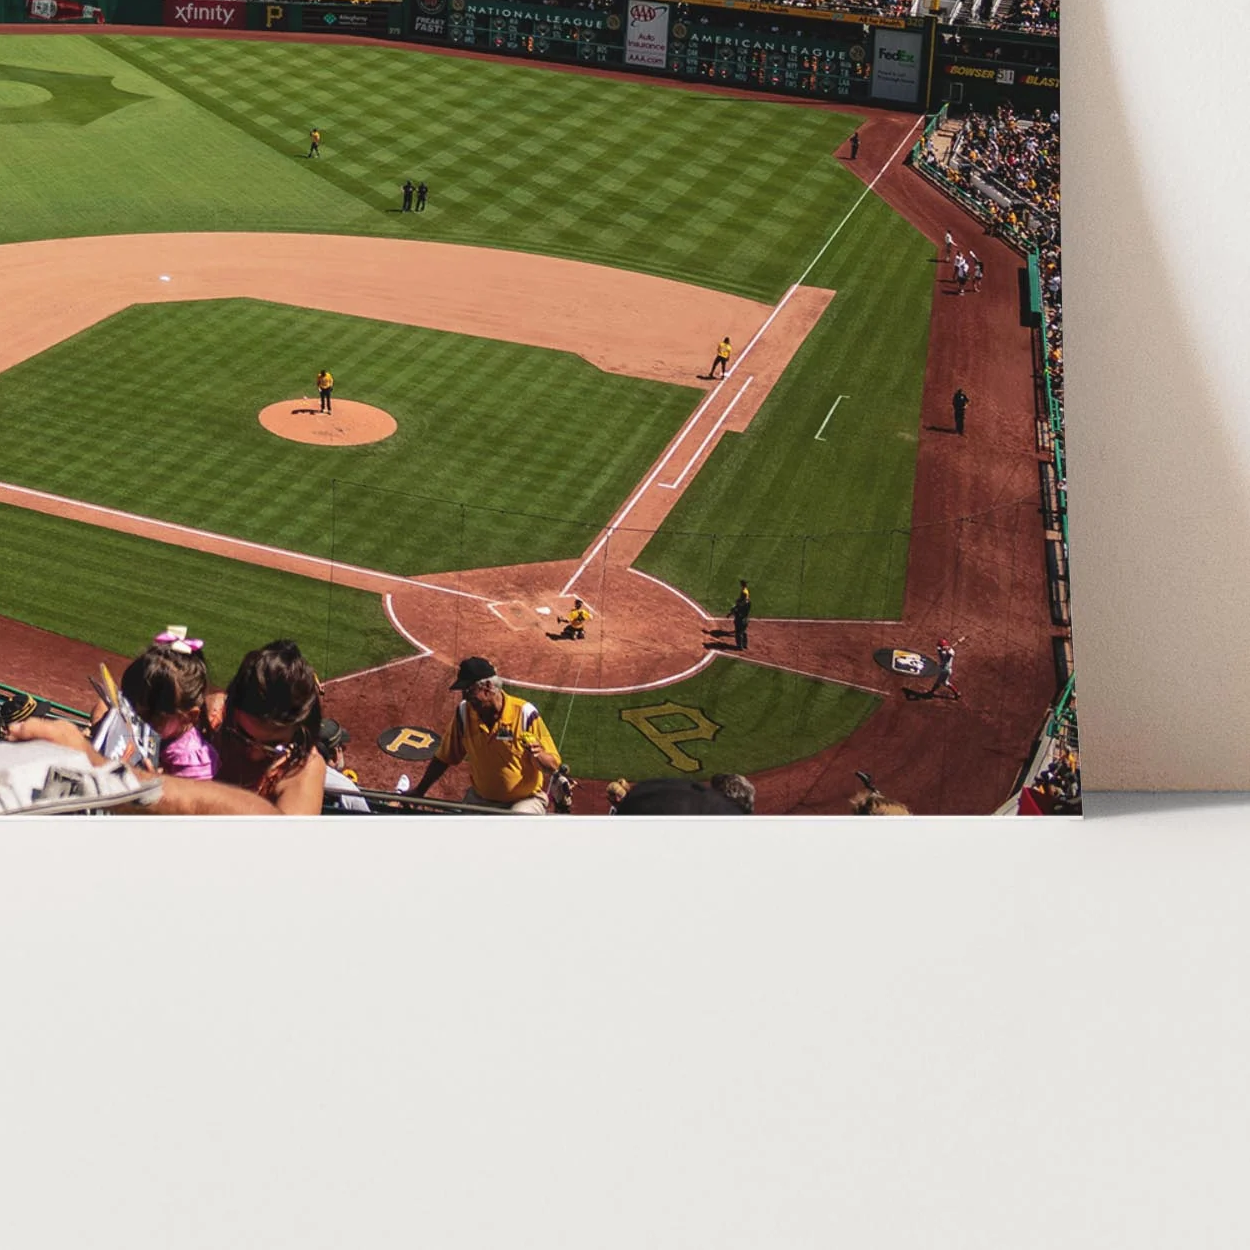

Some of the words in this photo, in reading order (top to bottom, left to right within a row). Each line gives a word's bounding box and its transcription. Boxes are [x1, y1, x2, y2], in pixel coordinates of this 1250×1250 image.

[174, 3, 236, 25] xfinity
[266, 5, 283, 28] P
[415, 16, 445, 25] FREAKY
[468, 5, 540, 21] NATIONAL
[546, 15, 603, 29] LEAGUE
[632, 5, 655, 21] AAA
[414, 23, 443, 34] FAST!
[628, 40, 666, 51] Insurance
[638, 33, 656, 42] Auto
[690, 33, 775, 50] AMERICAN
[781, 44, 846, 60] LEAGUE
[628, 54, 664, 64] AAA.com
[878, 47, 915, 63] FedEx
[950, 65, 996, 79] BOWSER
[385, 726, 435, 753] P
[618, 700, 724, 773] P
